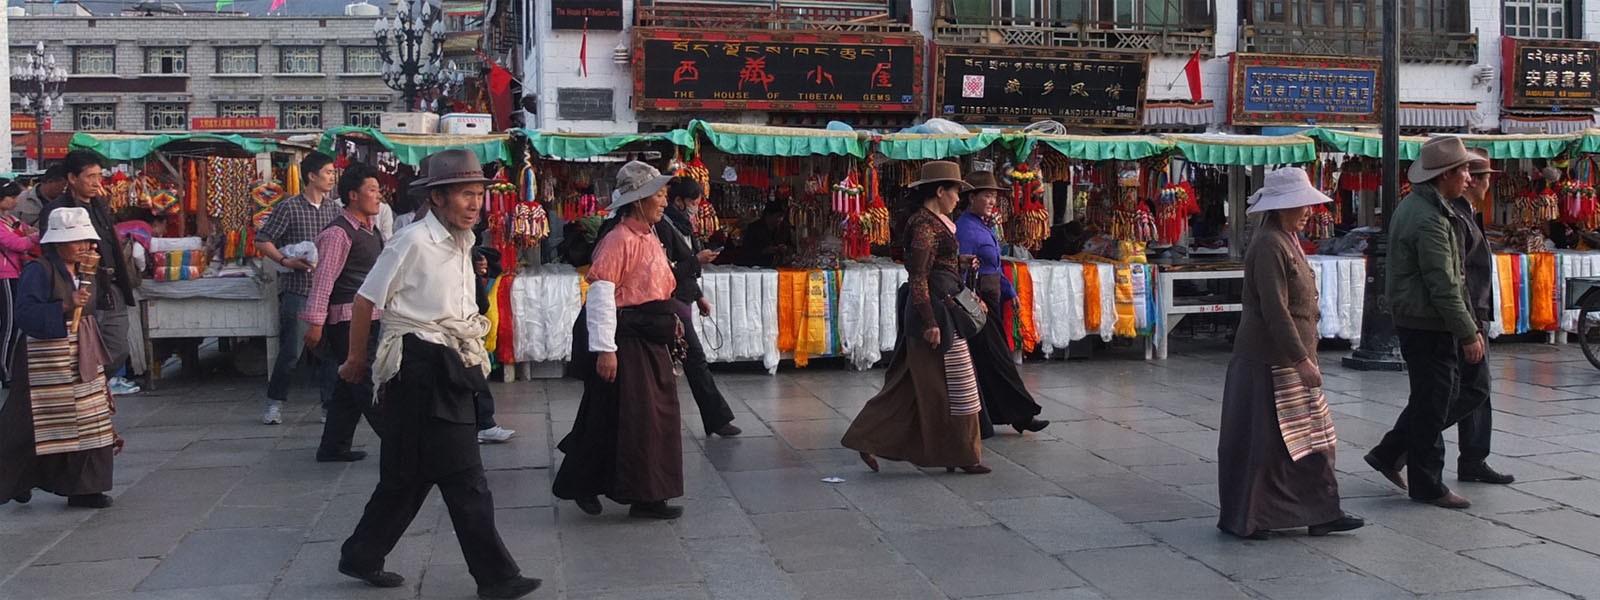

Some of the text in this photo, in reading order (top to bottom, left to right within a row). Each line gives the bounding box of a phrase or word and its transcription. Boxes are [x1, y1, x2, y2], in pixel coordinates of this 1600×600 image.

[673, 57, 892, 92] 西藏小屋
[673, 91, 695, 99] THE
[798, 92, 843, 100] TIBETAN
[961, 106, 998, 114] TIBETAN
[1000, 106, 1053, 115] TRADITIONAL
